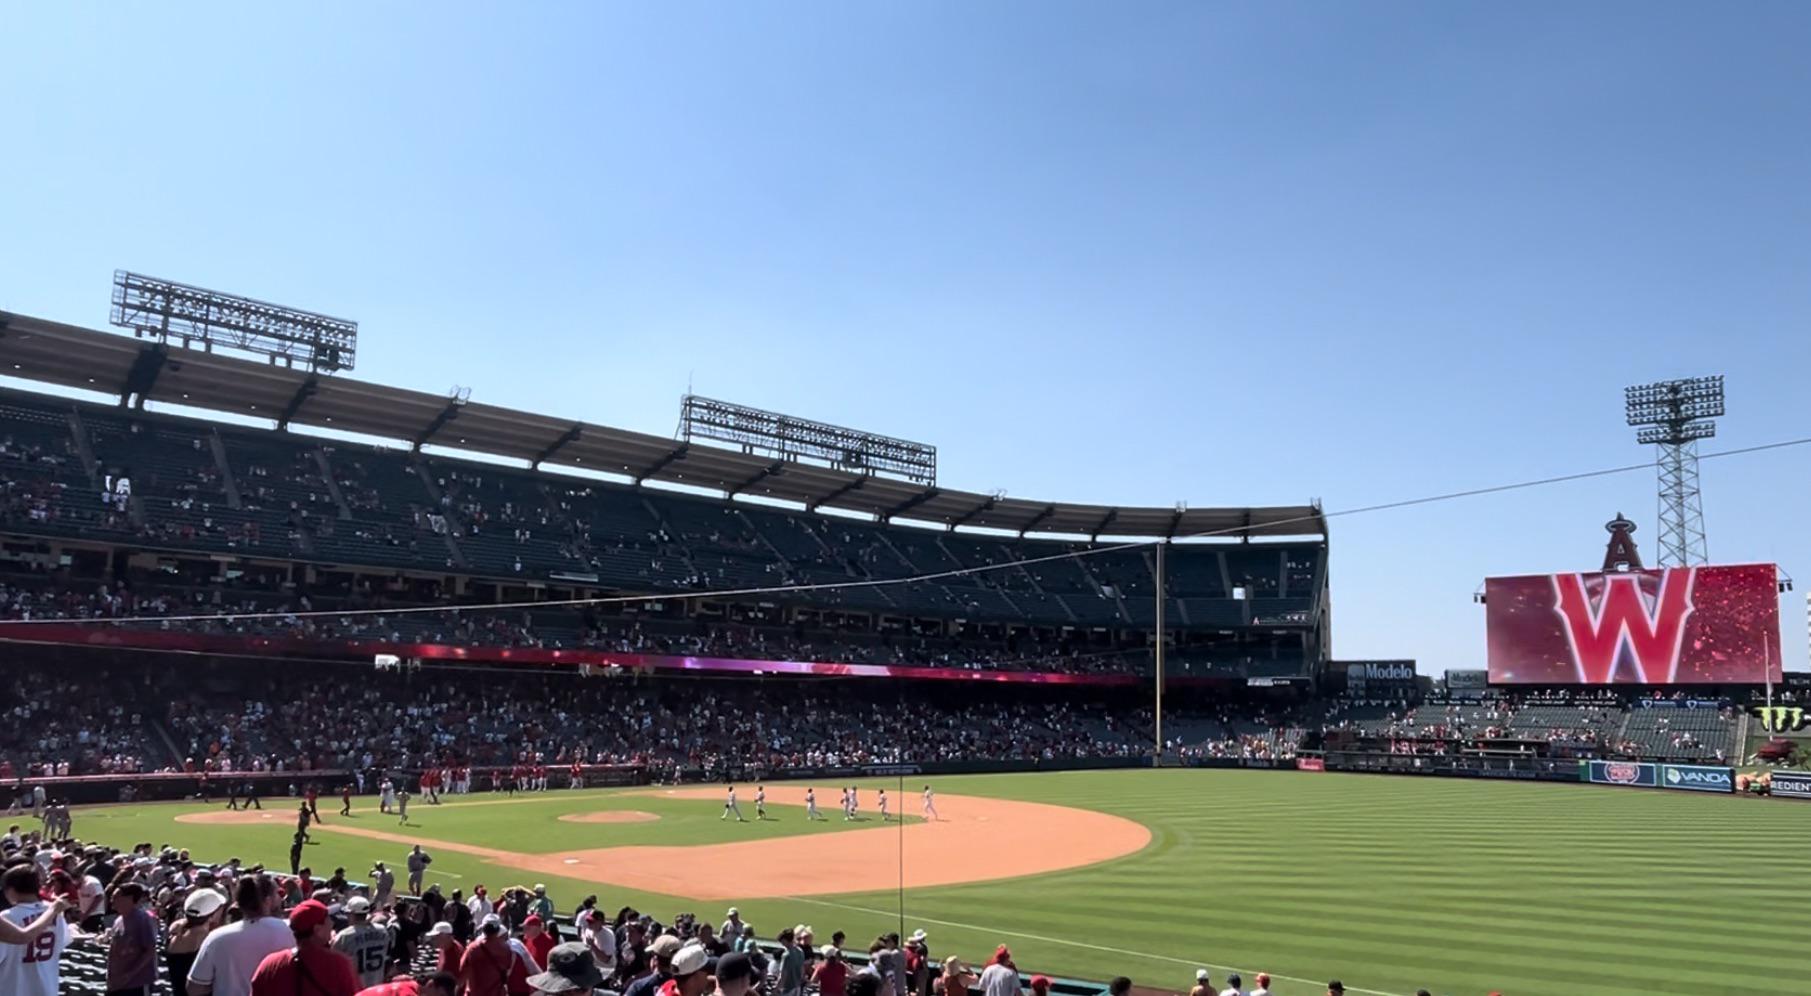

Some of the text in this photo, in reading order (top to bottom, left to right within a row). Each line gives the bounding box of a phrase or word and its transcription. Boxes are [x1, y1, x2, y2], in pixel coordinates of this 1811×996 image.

[1551, 566, 1696, 683] W
[1365, 663, 1413, 680] Modelo
[1681, 771, 1732, 784] VANDA
[356, 944, 385, 974] 15
